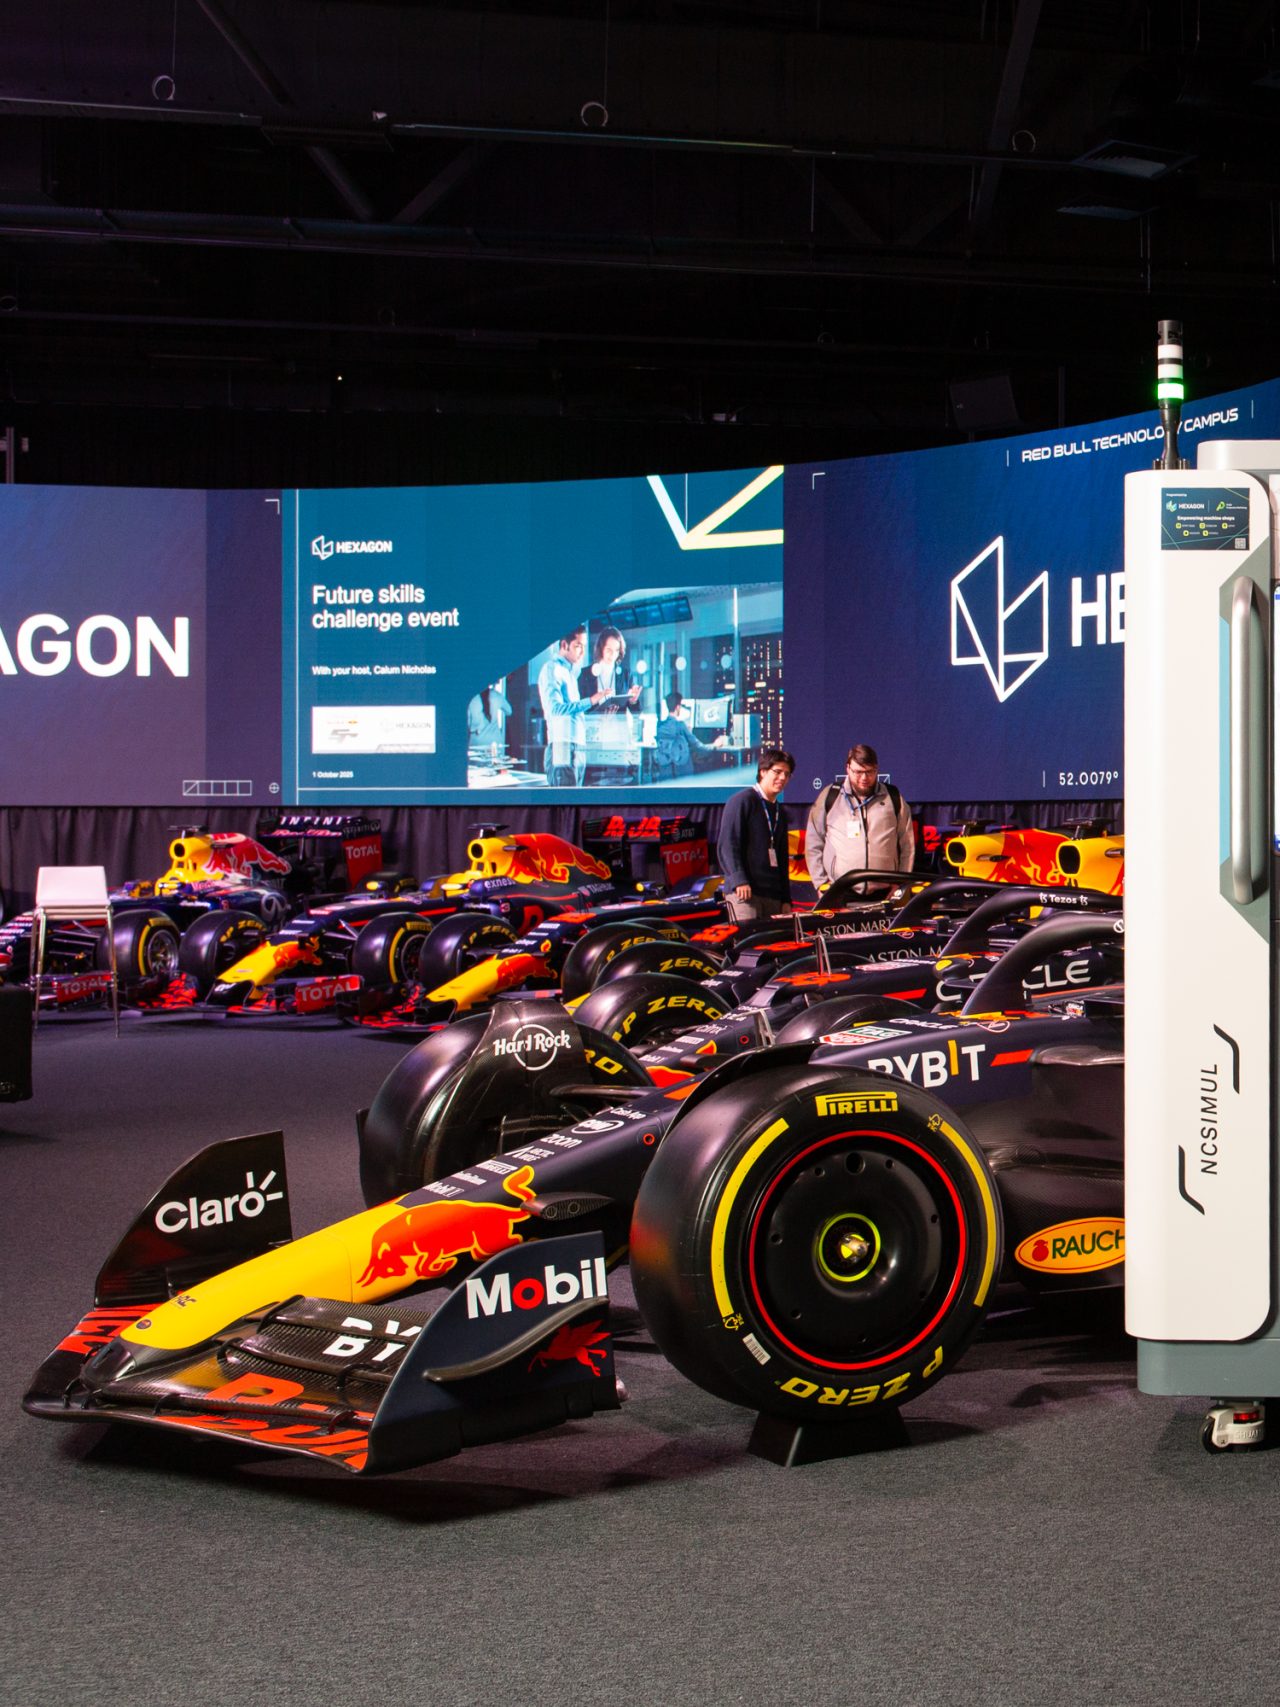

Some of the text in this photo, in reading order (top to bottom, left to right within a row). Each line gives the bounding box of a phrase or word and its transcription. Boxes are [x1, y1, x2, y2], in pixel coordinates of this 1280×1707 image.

[1021, 445, 1051, 463] RED
[1054, 439, 1091, 458] BULL
[1183, 407, 1239, 433] CAMPUS
[336, 540, 393, 554] HEXAGON
[311, 583, 426, 605] Future skills
[311, 608, 460, 630] challenge event
[312, 666, 331, 675] With
[332, 667, 351, 677] your
[351, 665, 372, 676] host,
[401, 665, 437, 674] Nicholas
[345, 844, 381, 860] TOTAL
[663, 847, 705, 864] TOTAL
[1050, 894, 1078, 904] Tezos
[815, 923, 856, 938] ASTON
[659, 957, 718, 977] ZERO
[62, 977, 107, 996] TOTAL
[298, 981, 352, 1001] TOTAL
[647, 996, 722, 1021] ZERO
[493, 1029, 571, 1056] Hard Rock
[815, 1090, 899, 1117] PIRELLI
[1200, 1063, 1218, 1175] NCSIMUL
[154, 1189, 265, 1234] Claro
[466, 1257, 608, 1320] Mobil
[780, 1345, 944, 1407] P ZERO
